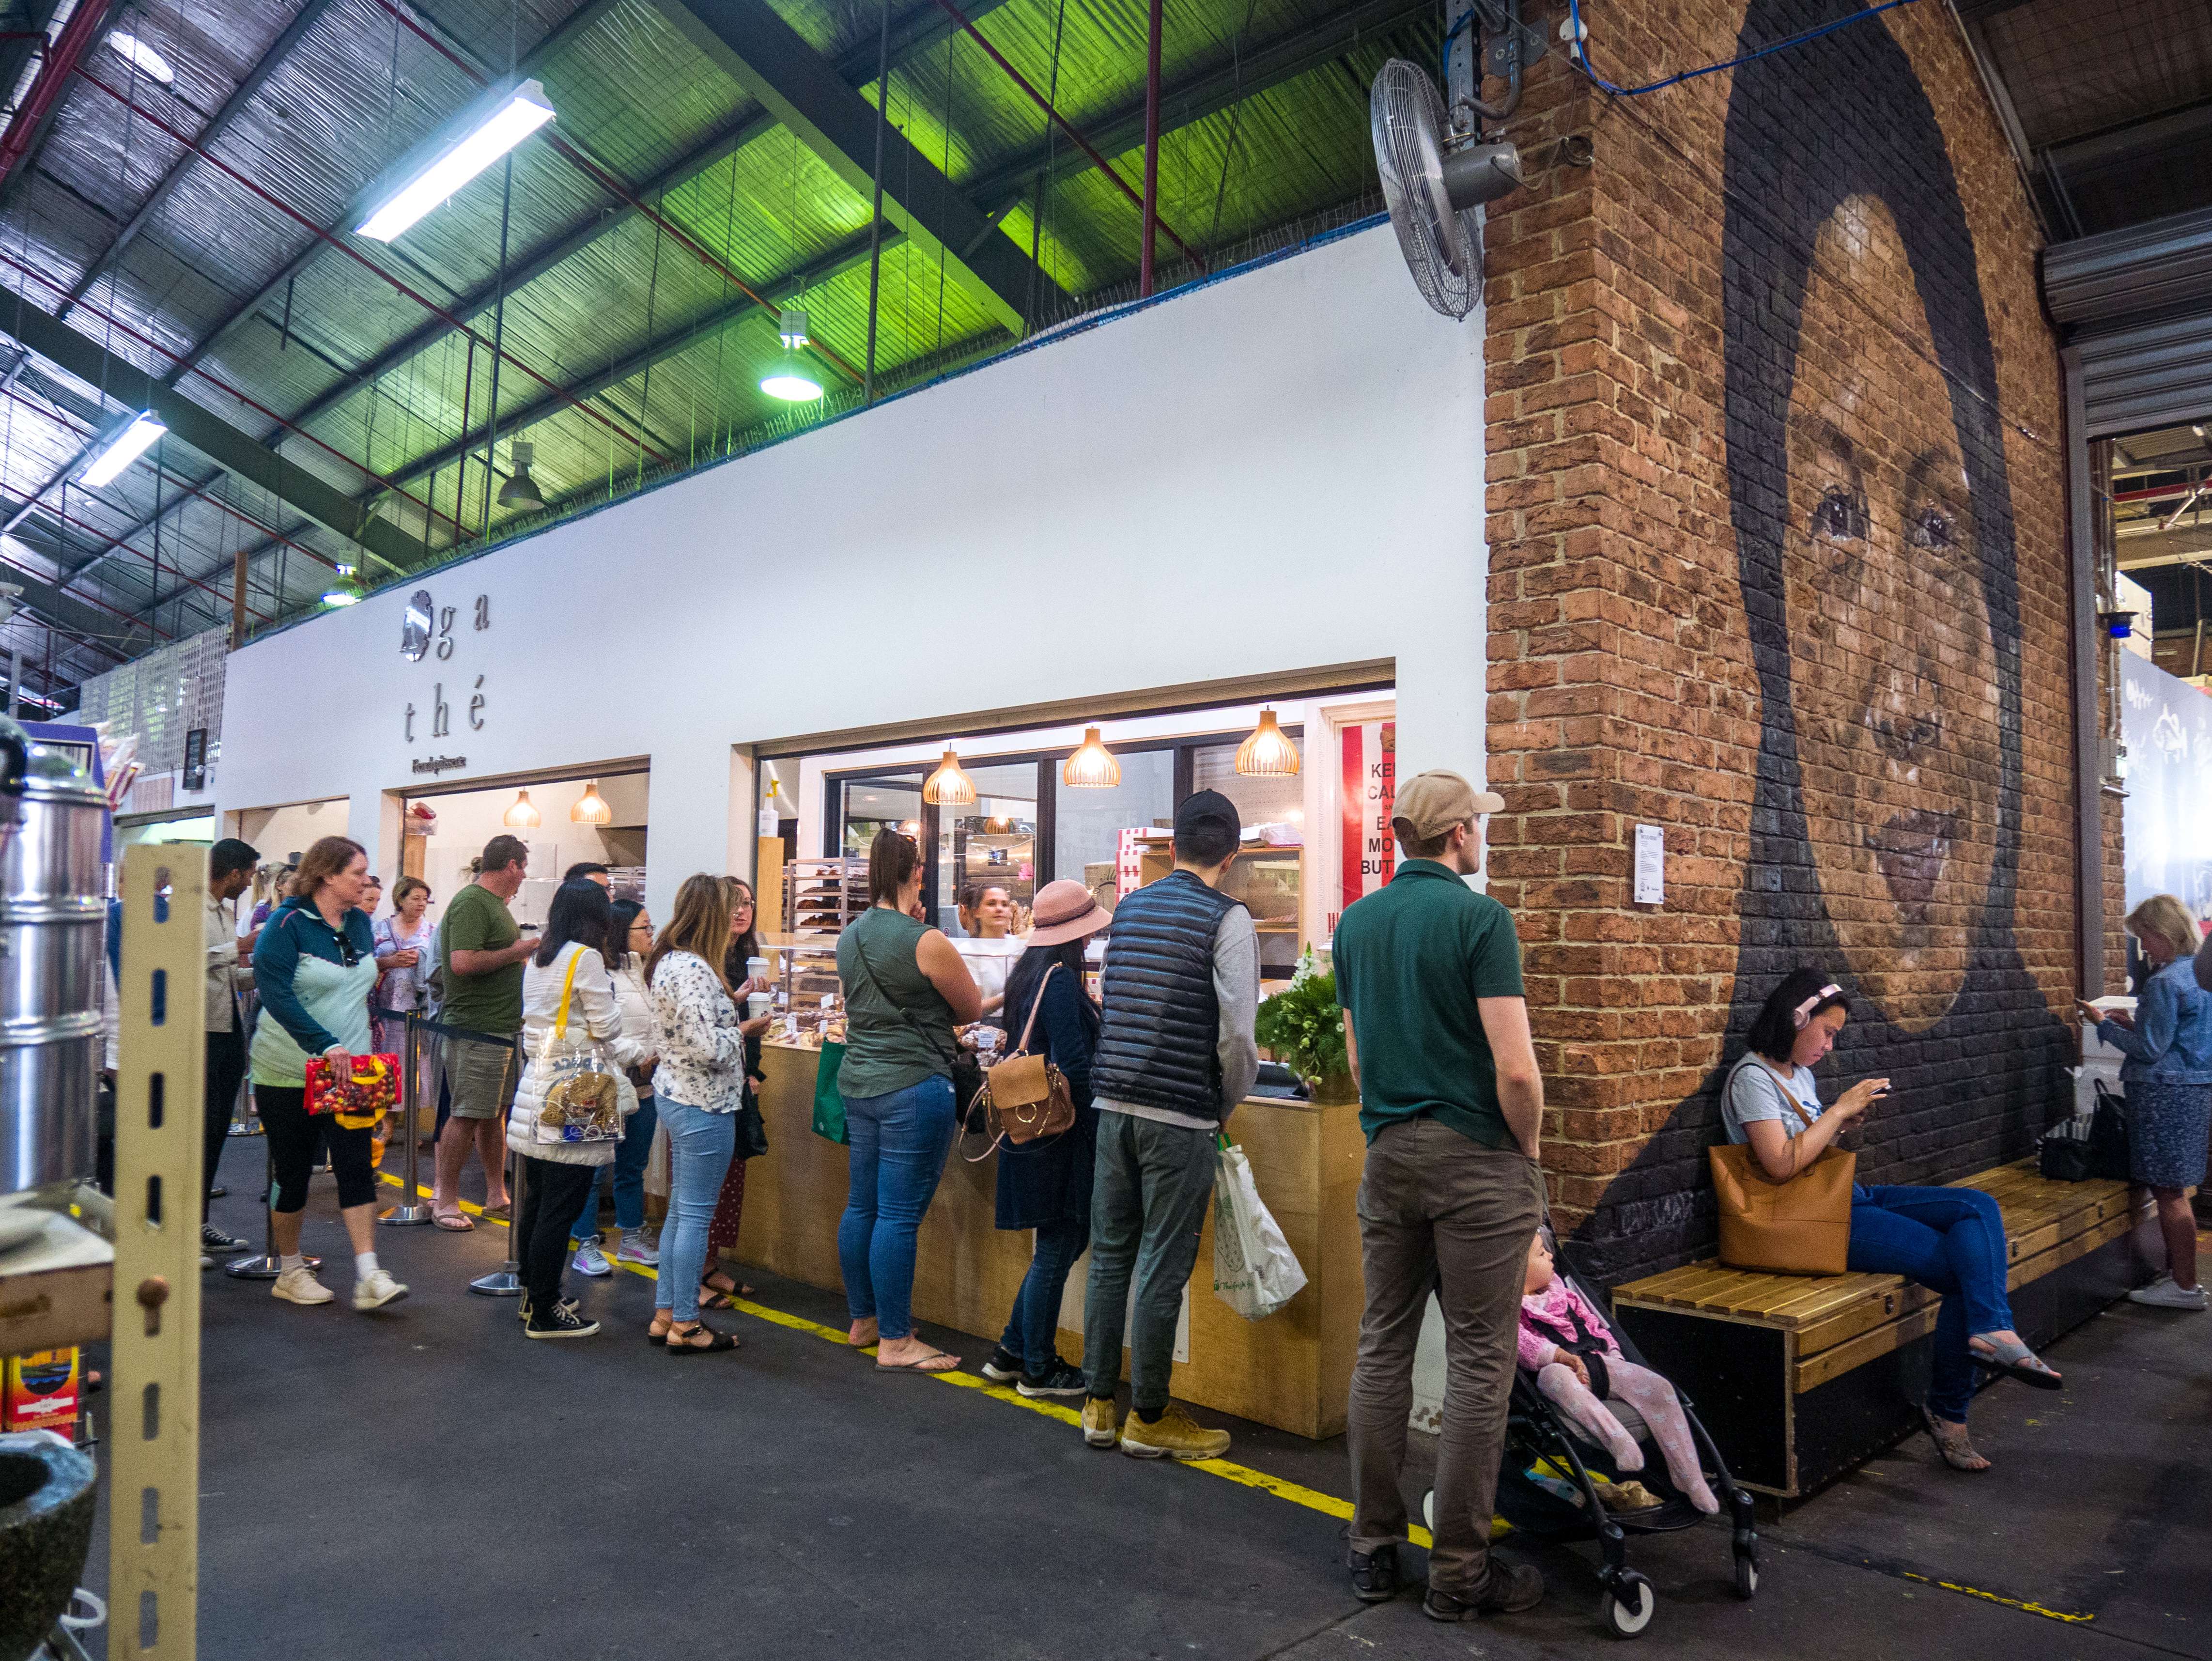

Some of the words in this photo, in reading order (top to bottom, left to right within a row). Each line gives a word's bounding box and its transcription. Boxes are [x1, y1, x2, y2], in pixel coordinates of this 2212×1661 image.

[404, 674, 485, 743] thé
[1369, 838, 1393, 853] MO
[1361, 859, 1395, 874] BUT
